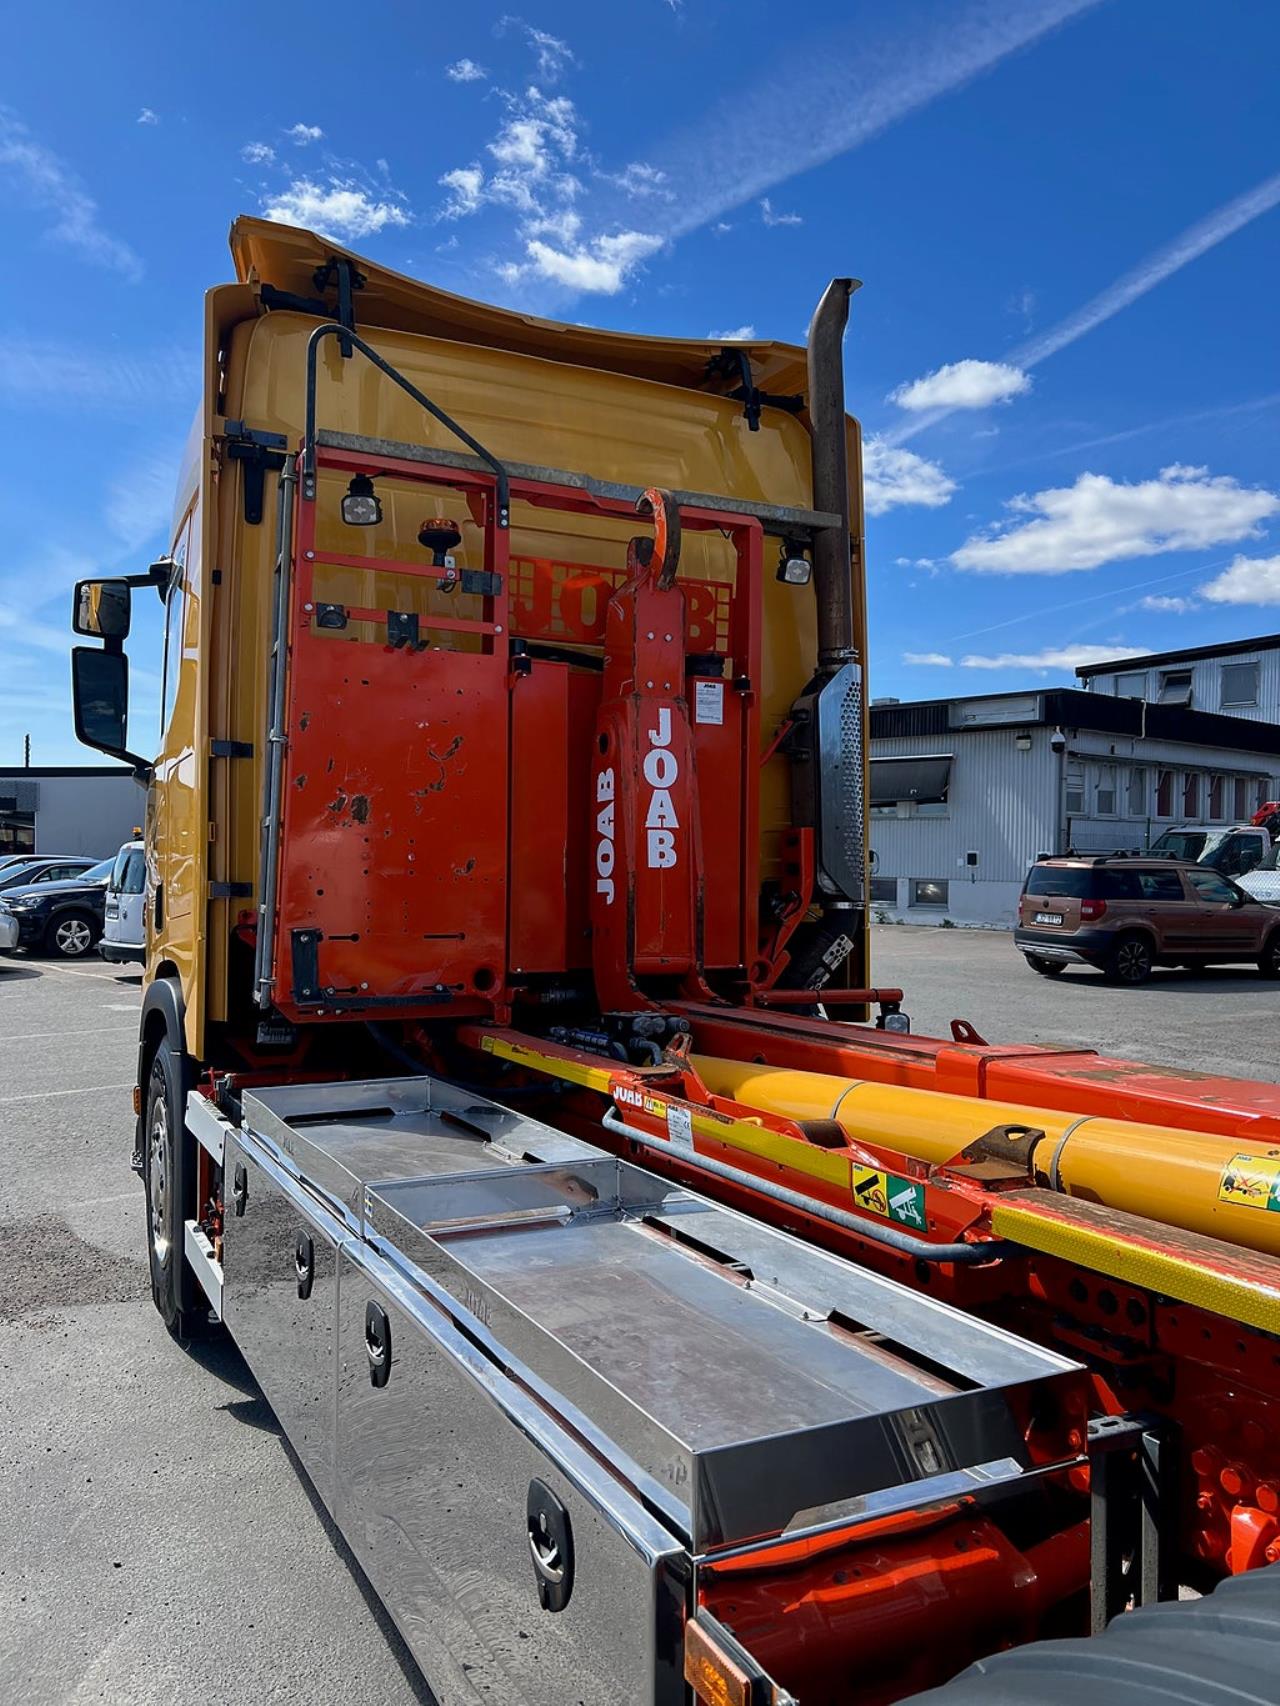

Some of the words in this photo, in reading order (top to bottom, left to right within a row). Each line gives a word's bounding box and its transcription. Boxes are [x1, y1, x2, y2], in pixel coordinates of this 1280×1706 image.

[514, 560, 717, 651] JOB
[597, 767, 615, 905] JOAB
[643, 708, 679, 868] JOAB
